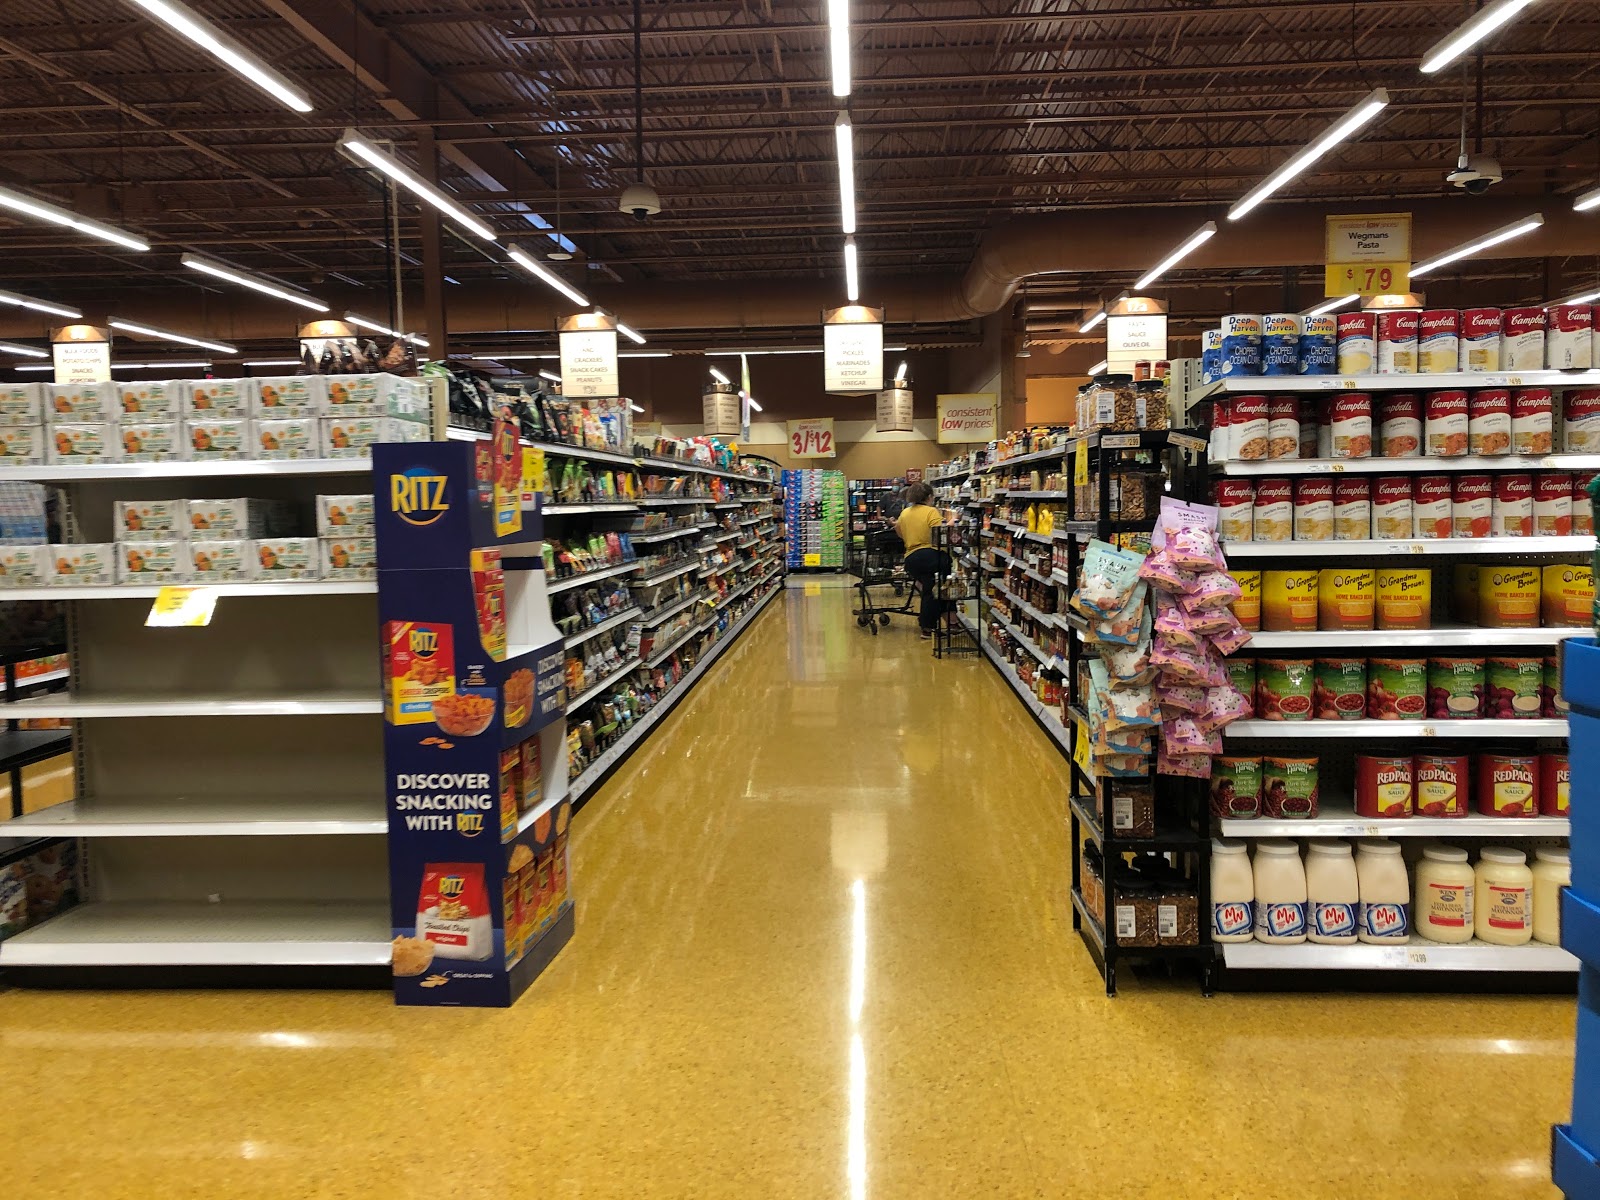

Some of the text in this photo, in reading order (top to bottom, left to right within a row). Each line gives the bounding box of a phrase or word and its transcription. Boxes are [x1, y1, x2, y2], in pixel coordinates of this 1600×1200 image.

[1348, 232, 1389, 241] Wegmans
[1358, 241, 1380, 249] Pasta
[1229, 316, 1251, 325] Deep
[1265, 316, 1286, 325] Deep
[1305, 316, 1327, 325] Deep
[1230, 324, 1258, 332] Harvest
[1266, 324, 1295, 332] Harvest
[1307, 324, 1334, 332] Harvest
[947, 407, 992, 418] consistent
[942, 418, 995, 431] low prices!
[390, 474, 449, 513] RITZ
[1345, 572, 1370, 586] Grandma
[1388, 574, 1417, 588] Grandma
[1504, 571, 1533, 584] Grandma
[1517, 576, 1539, 589] Brown's
[1401, 579, 1425, 592] Brown's
[1563, 589, 1576, 597] HOME
[409, 630, 439, 652] RITZ
[397, 774, 490, 790] DISCOVER
[1418, 769, 1457, 784] REDPACK
[1494, 770, 1533, 784] REDPACK
[396, 795, 492, 811] SNACKING
[405, 812, 484, 832] WITH RITZ
[439, 877, 465, 894] RITZ
[1225, 907, 1243, 924] MW
[1277, 907, 1295, 925] MW
[1325, 907, 1345, 924] MW
[1376, 907, 1396, 925] MW
[424, 922, 452, 931] Toasted
